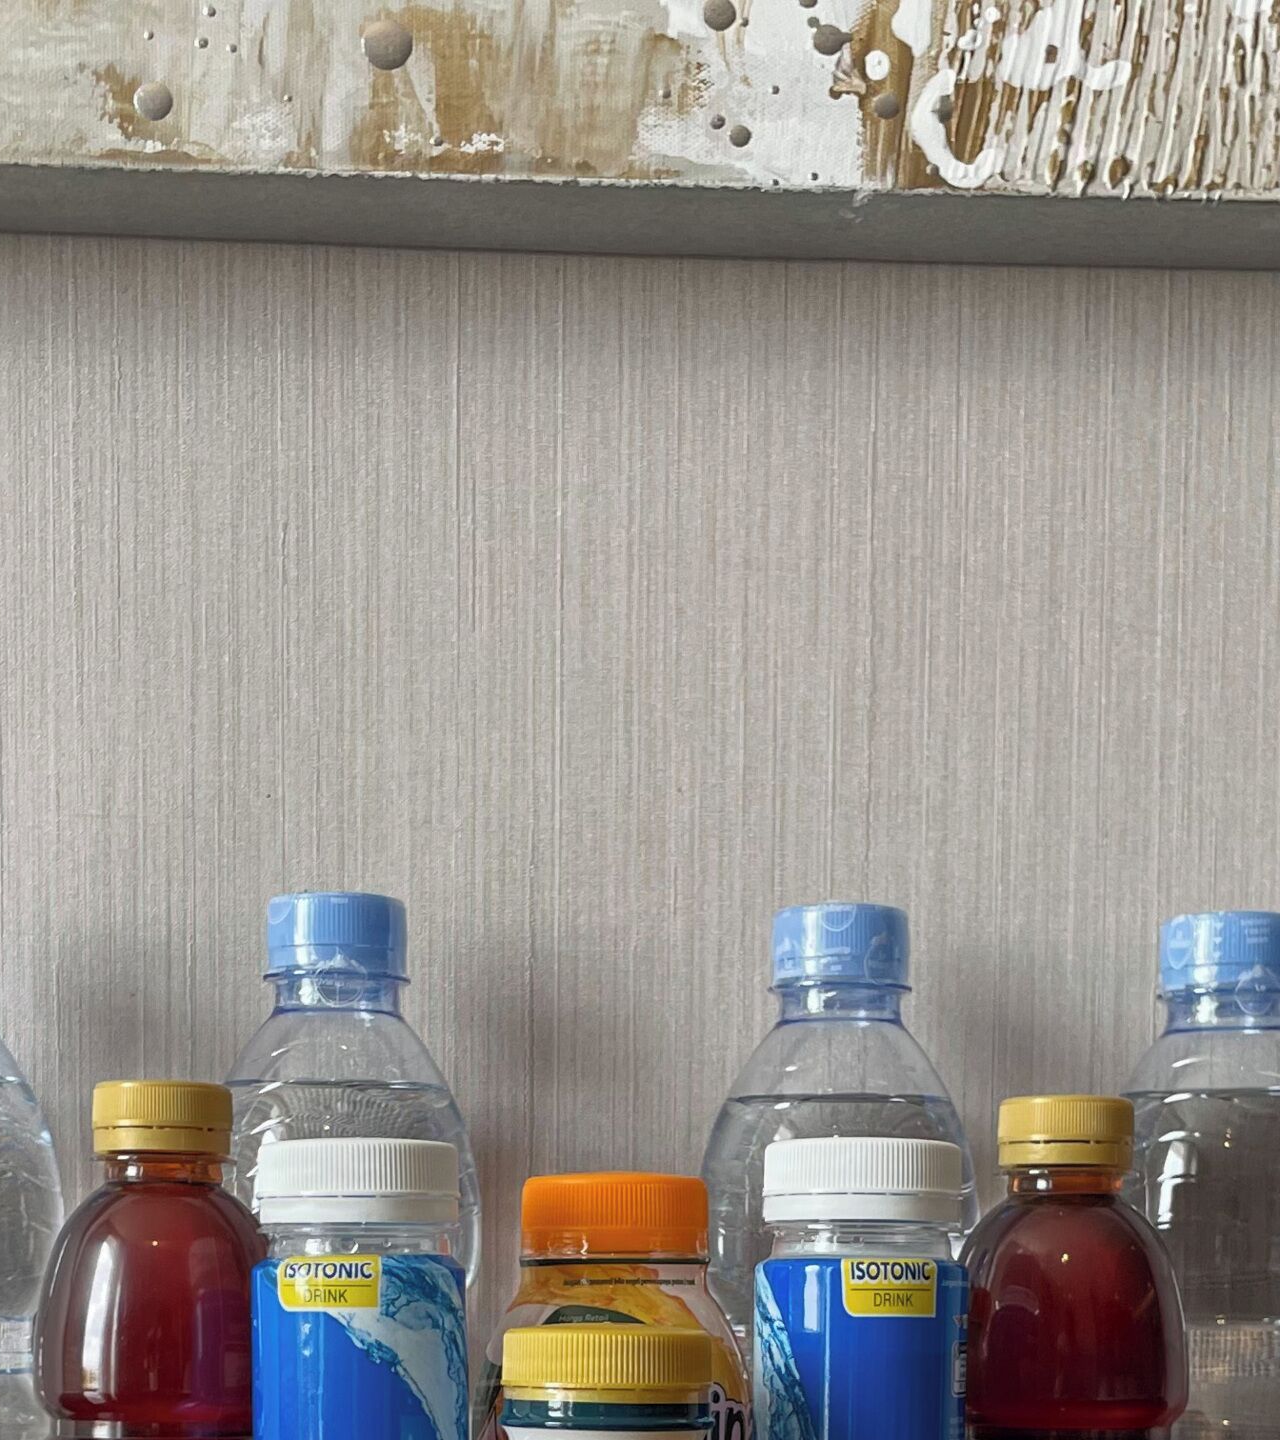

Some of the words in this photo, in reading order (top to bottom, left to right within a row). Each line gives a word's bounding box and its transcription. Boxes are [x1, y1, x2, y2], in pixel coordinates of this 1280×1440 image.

[284, 1262, 373, 1279] ISOTONIC
[850, 1261, 931, 1281] ISOTONIC
[303, 1288, 348, 1303] DRINK
[873, 1292, 914, 1307] DRINK
